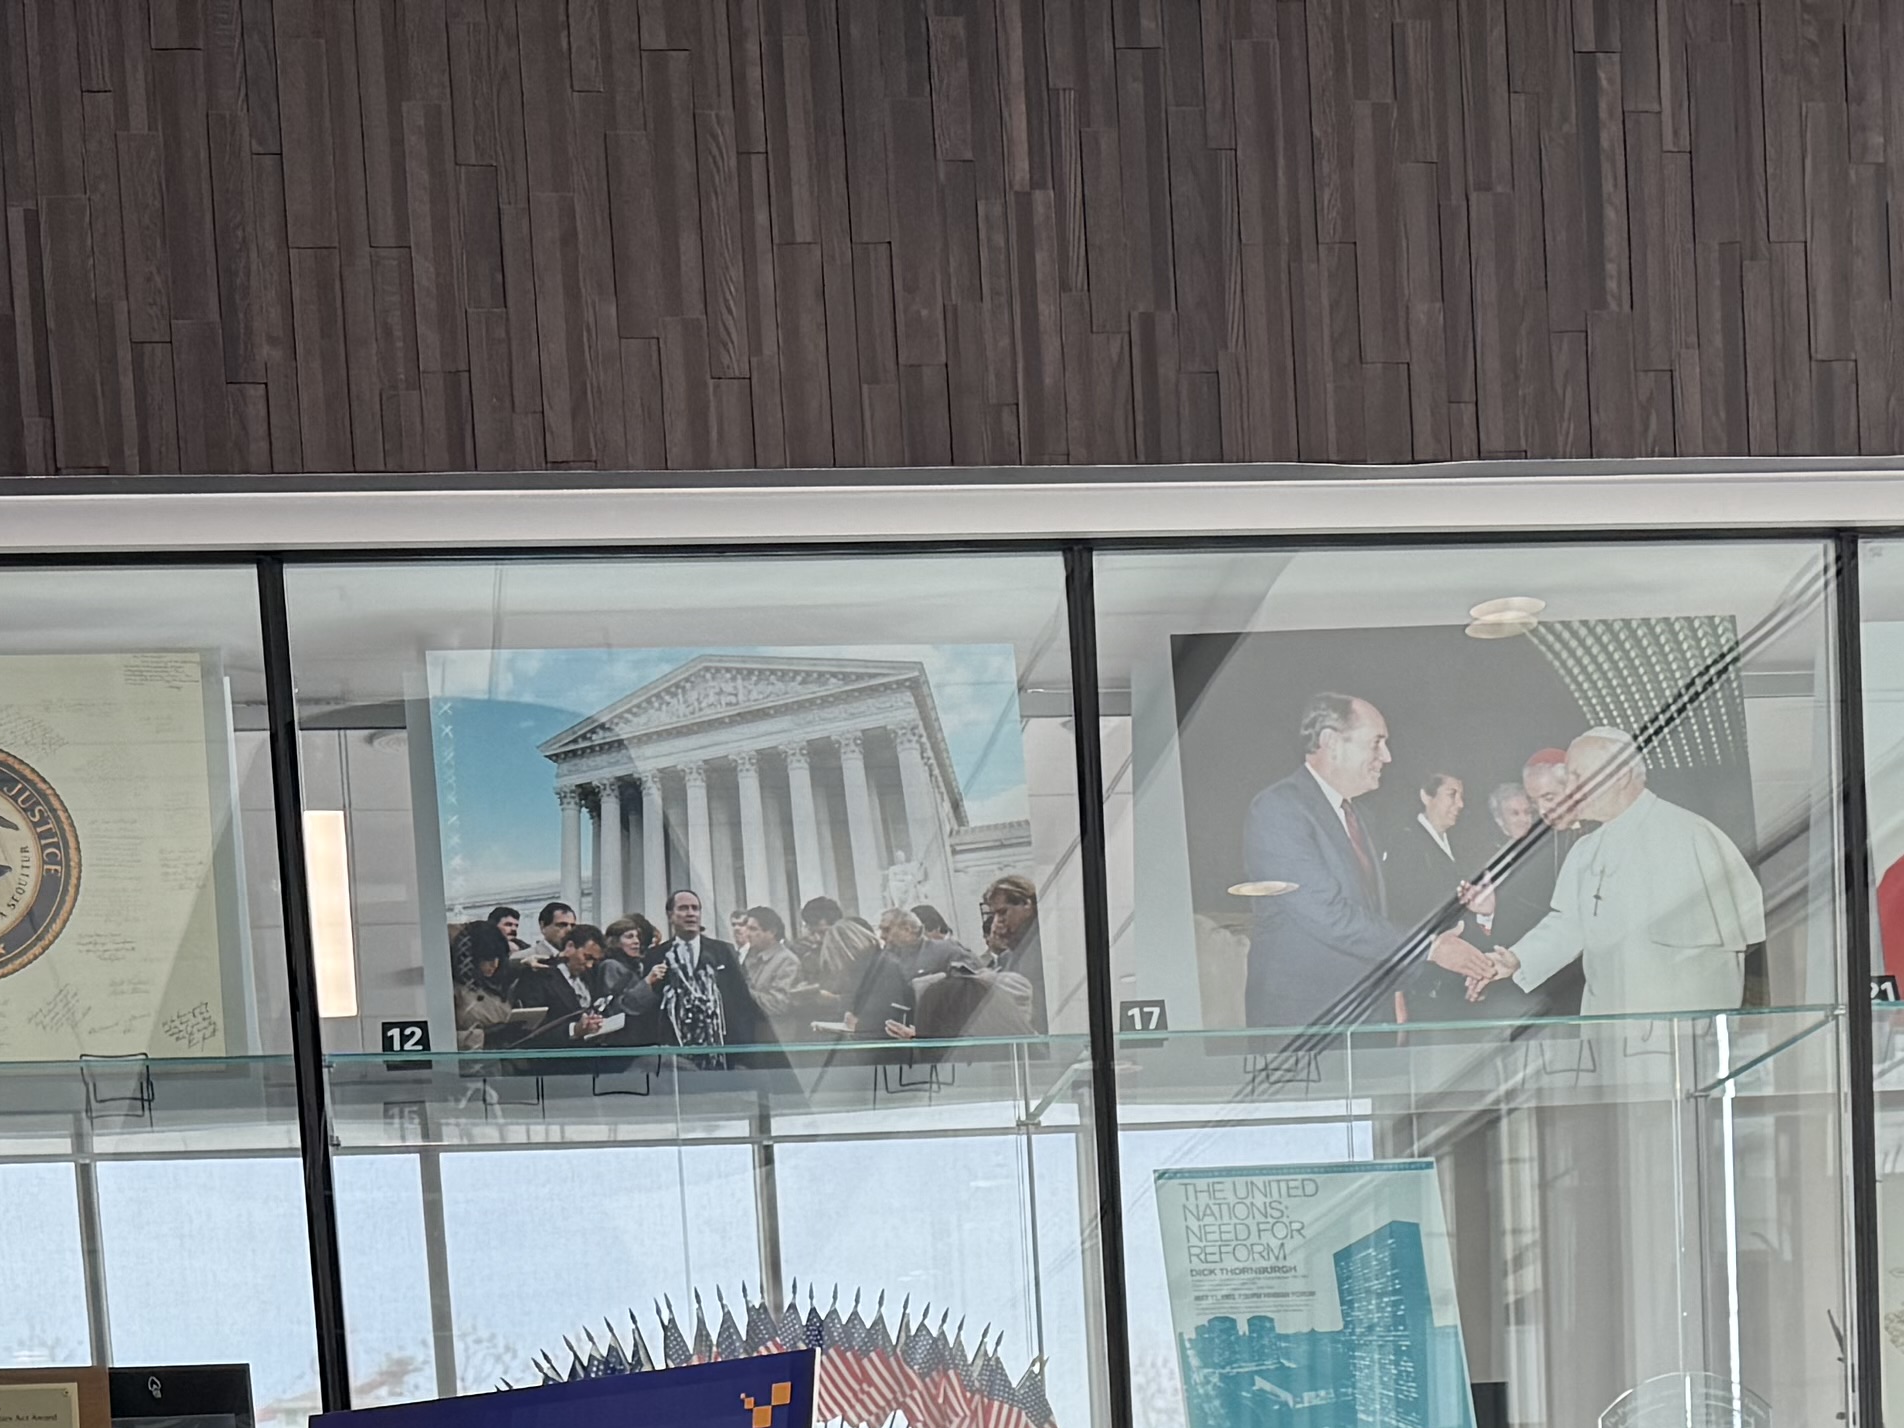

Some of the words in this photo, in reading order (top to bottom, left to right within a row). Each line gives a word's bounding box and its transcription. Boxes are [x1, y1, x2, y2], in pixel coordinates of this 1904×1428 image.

[3, 782, 61, 876] JUSTICE
[7, 845, 30, 911] SEQUITUR
[1127, 1006, 1160, 1030] 17
[387, 1026, 424, 1052] 12
[1178, 1181, 1226, 1201] THE
[1232, 1178, 1319, 1200] UNITED
[1182, 1200, 1290, 1222] NATIONS:
[1185, 1223, 1251, 1243] NEED
[1257, 1220, 1306, 1241] FOR
[1187, 1242, 1287, 1264] REFORM
[1190, 1268, 1217, 1277] DICK
[1219, 1265, 1298, 1276] THORNBURGH
